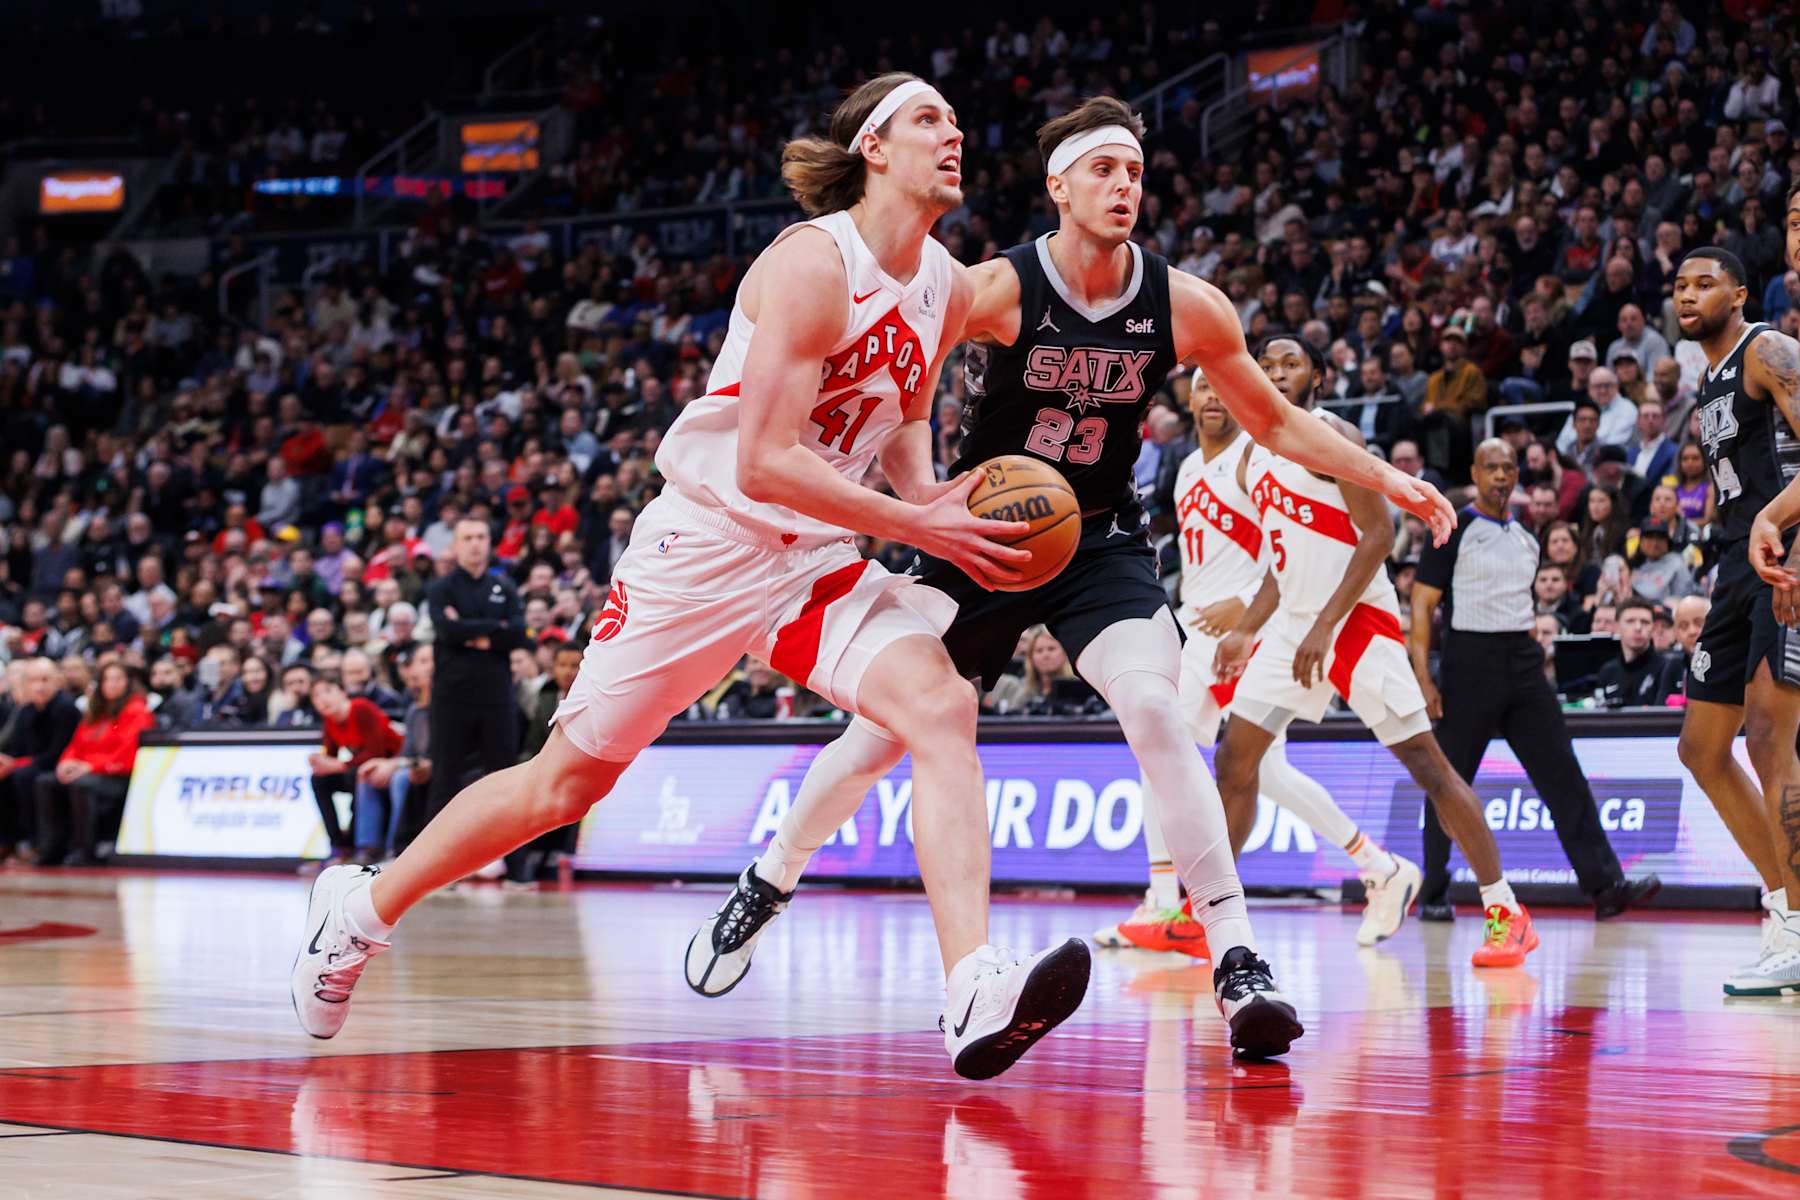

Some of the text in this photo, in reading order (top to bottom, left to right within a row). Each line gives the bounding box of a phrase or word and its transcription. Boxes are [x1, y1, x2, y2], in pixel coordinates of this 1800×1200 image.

[1125, 318, 1155, 334] Self.
[818, 324, 921, 393] RAPTOR
[1023, 345, 1155, 404] SATX
[809, 388, 884, 455] 41
[1024, 407, 1108, 465] 23
[1697, 391, 1740, 447] ATX
[1177, 485, 1233, 532] PTORS
[1184, 527, 1204, 566] 11
[1269, 529, 1286, 573] 5
